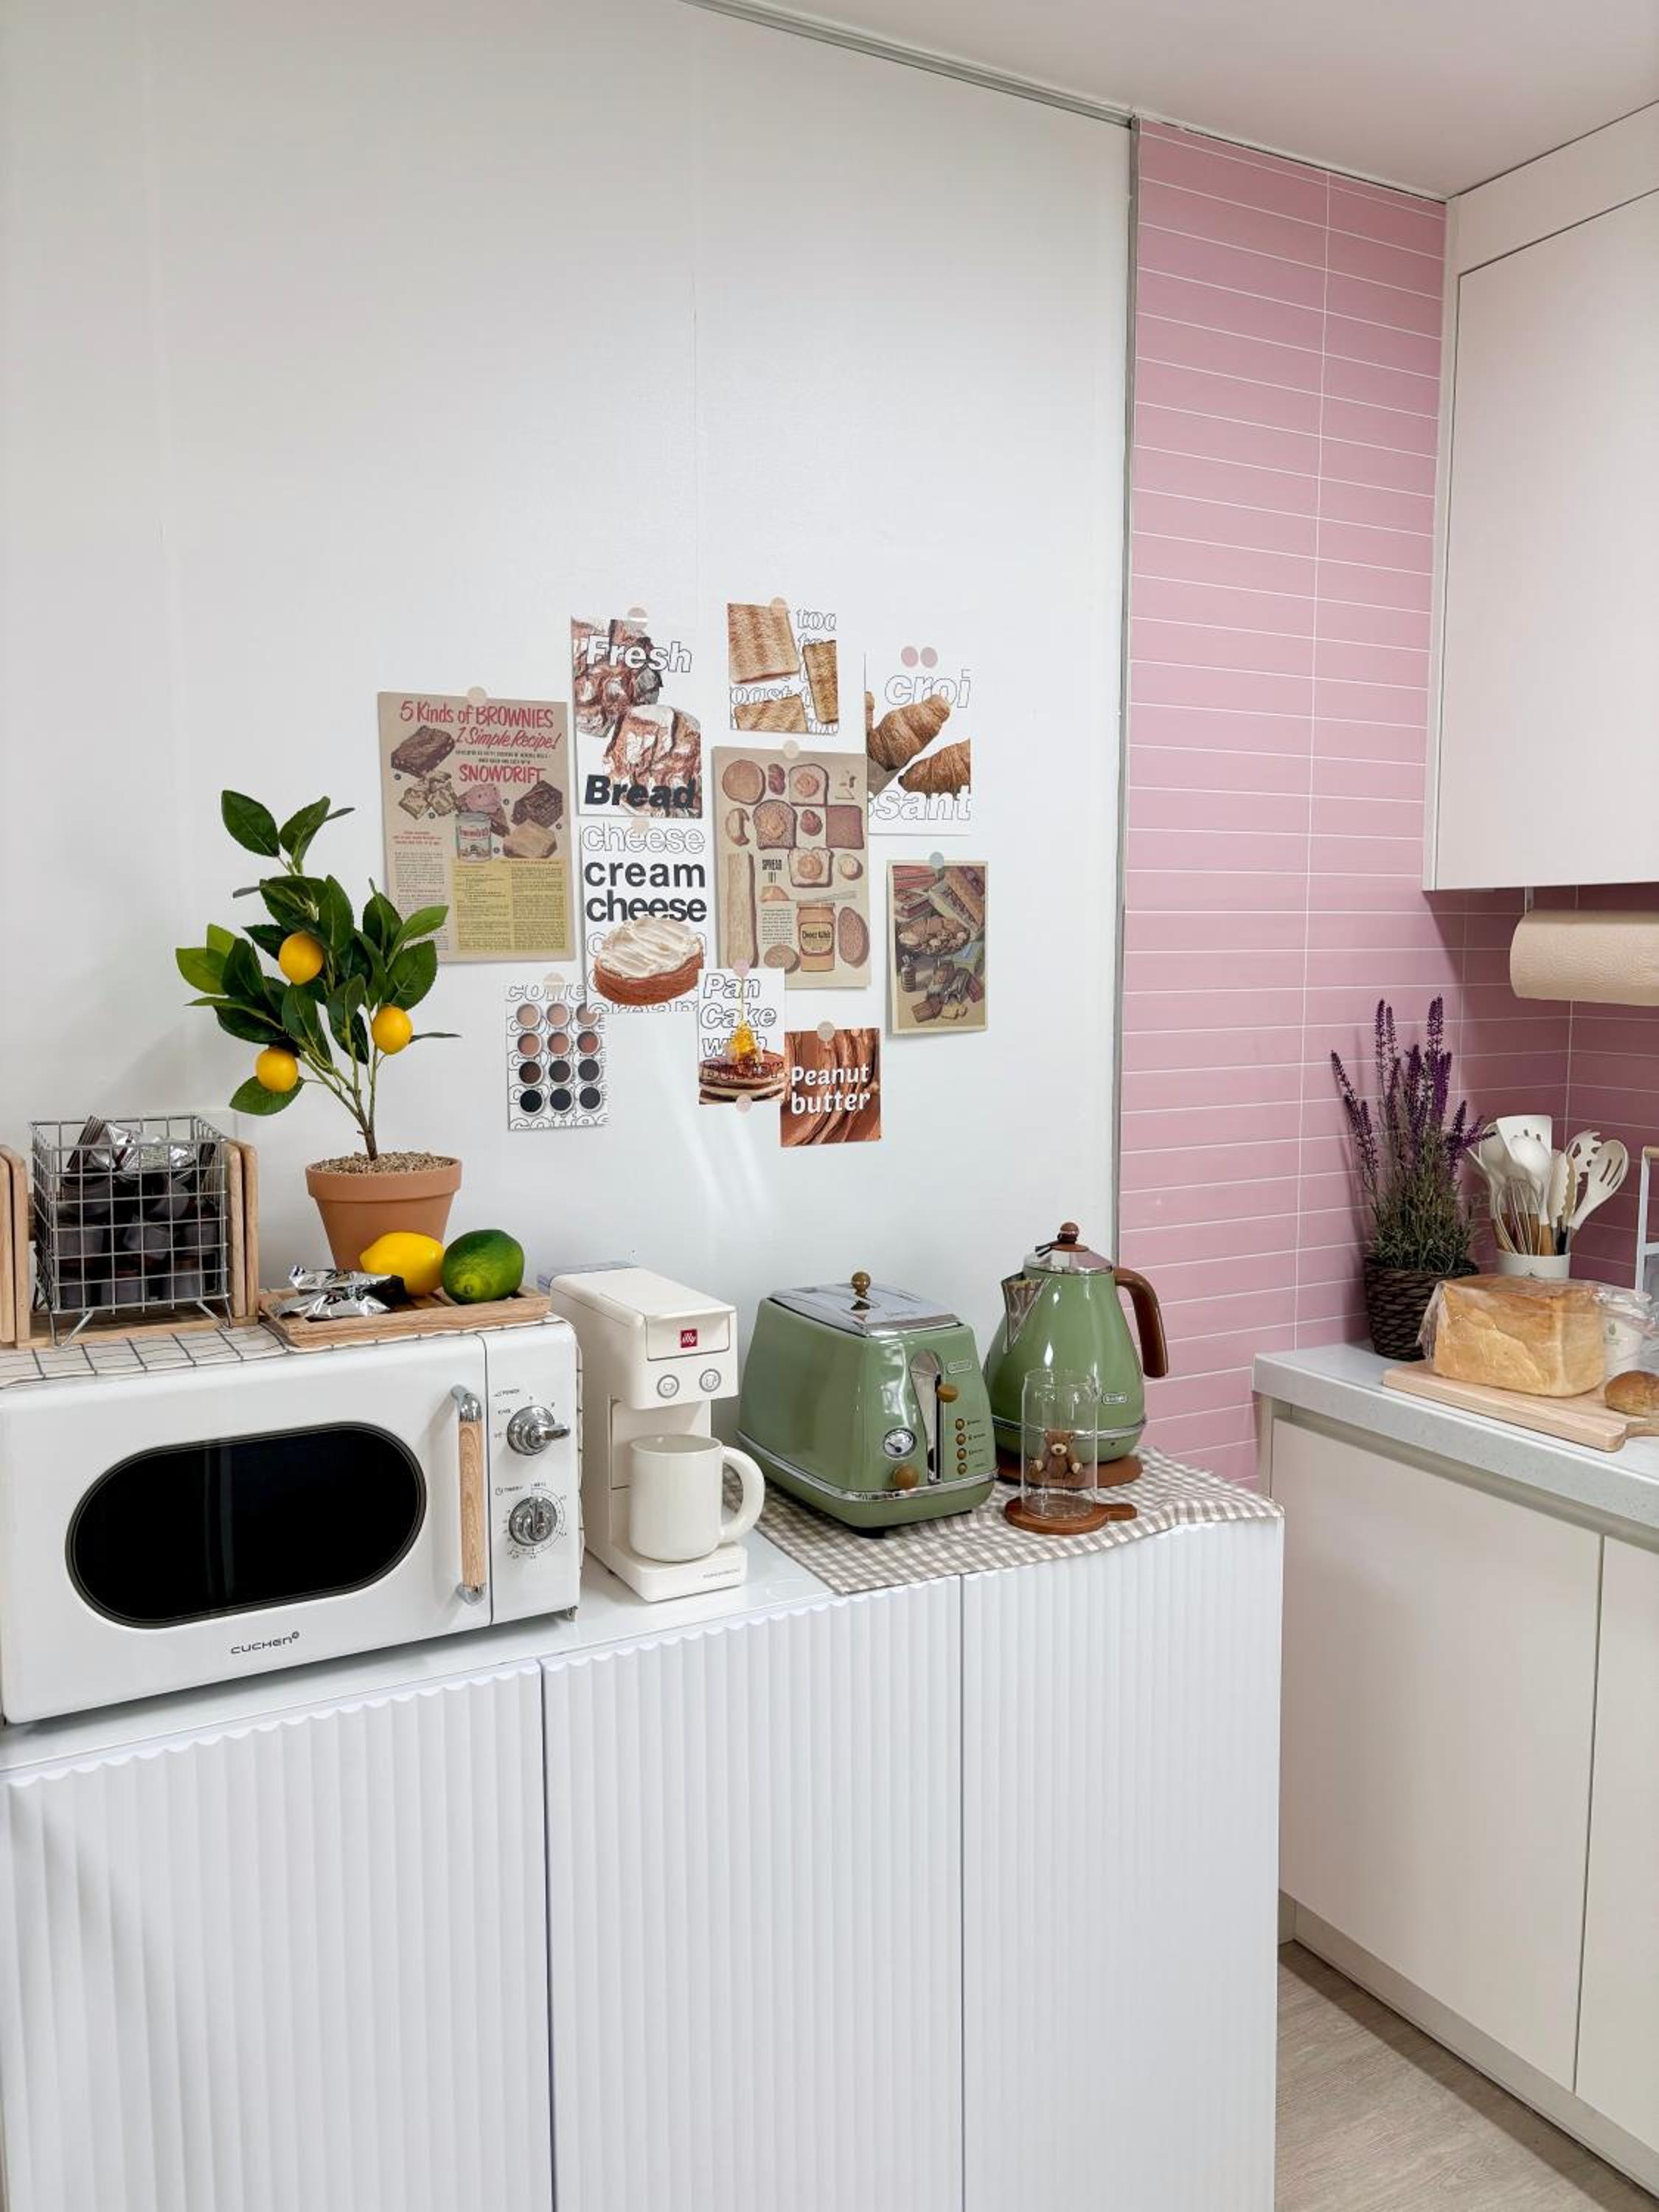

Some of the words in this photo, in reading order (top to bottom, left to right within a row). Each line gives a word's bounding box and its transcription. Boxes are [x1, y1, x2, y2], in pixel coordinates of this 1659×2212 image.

[587, 635, 693, 672] Fresh
[885, 669, 971, 709] croi
[400, 701, 414, 722] 5
[417, 702, 453, 724] Kinds
[458, 705, 474, 725] of
[476, 706, 554, 729] BROWNIES
[466, 726, 510, 750] Simple
[509, 730, 562, 752] Recipe!
[459, 763, 546, 785] SNOWDRIFT
[585, 775, 697, 808] Bread
[582, 823, 706, 854] cheese
[585, 861, 706, 888] cream
[586, 889, 707, 922] cheese
[703, 973, 760, 998] Pan
[700, 1003, 776, 1030] Cake
[790, 1062, 869, 1086] Peanut
[790, 1091, 871, 1115] butter
